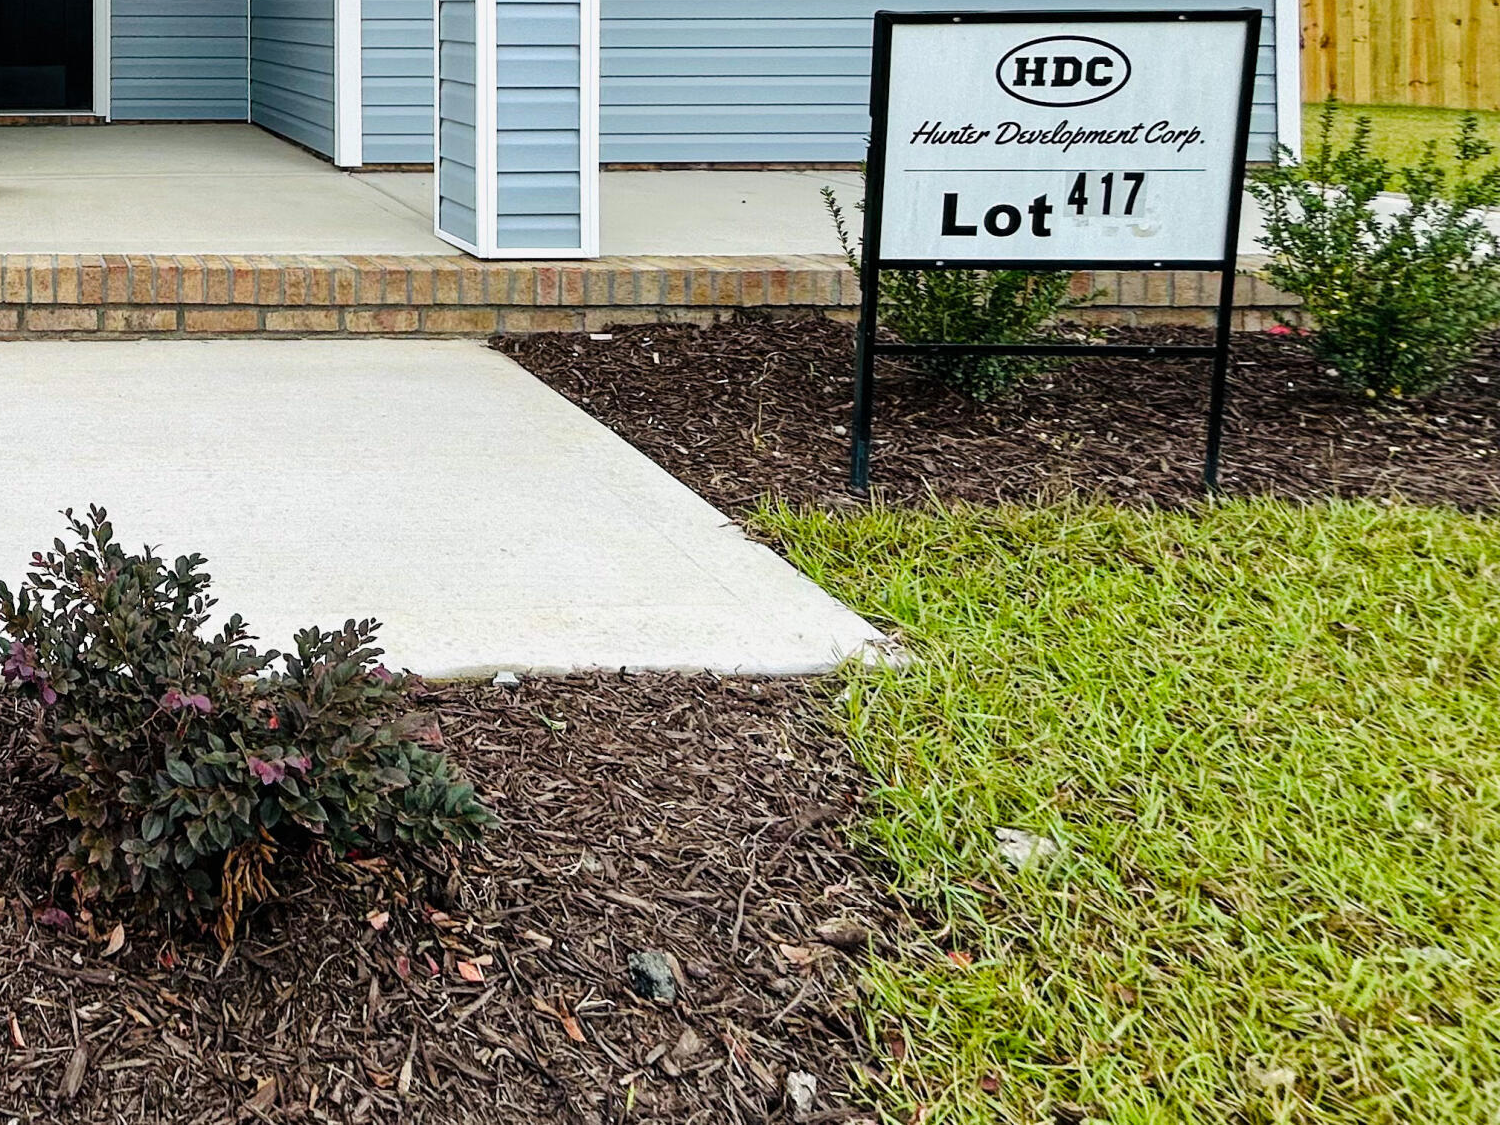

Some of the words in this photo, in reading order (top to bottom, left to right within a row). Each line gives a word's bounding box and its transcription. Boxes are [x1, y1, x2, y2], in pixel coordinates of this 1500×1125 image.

[1012, 56, 1114, 87] HDC
[909, 121, 990, 145] Hunter
[994, 120, 1143, 152] Development
[1144, 120, 1206, 152] Corp.
[941, 192, 1053, 237] Lot
[1067, 172, 1146, 216] 417
